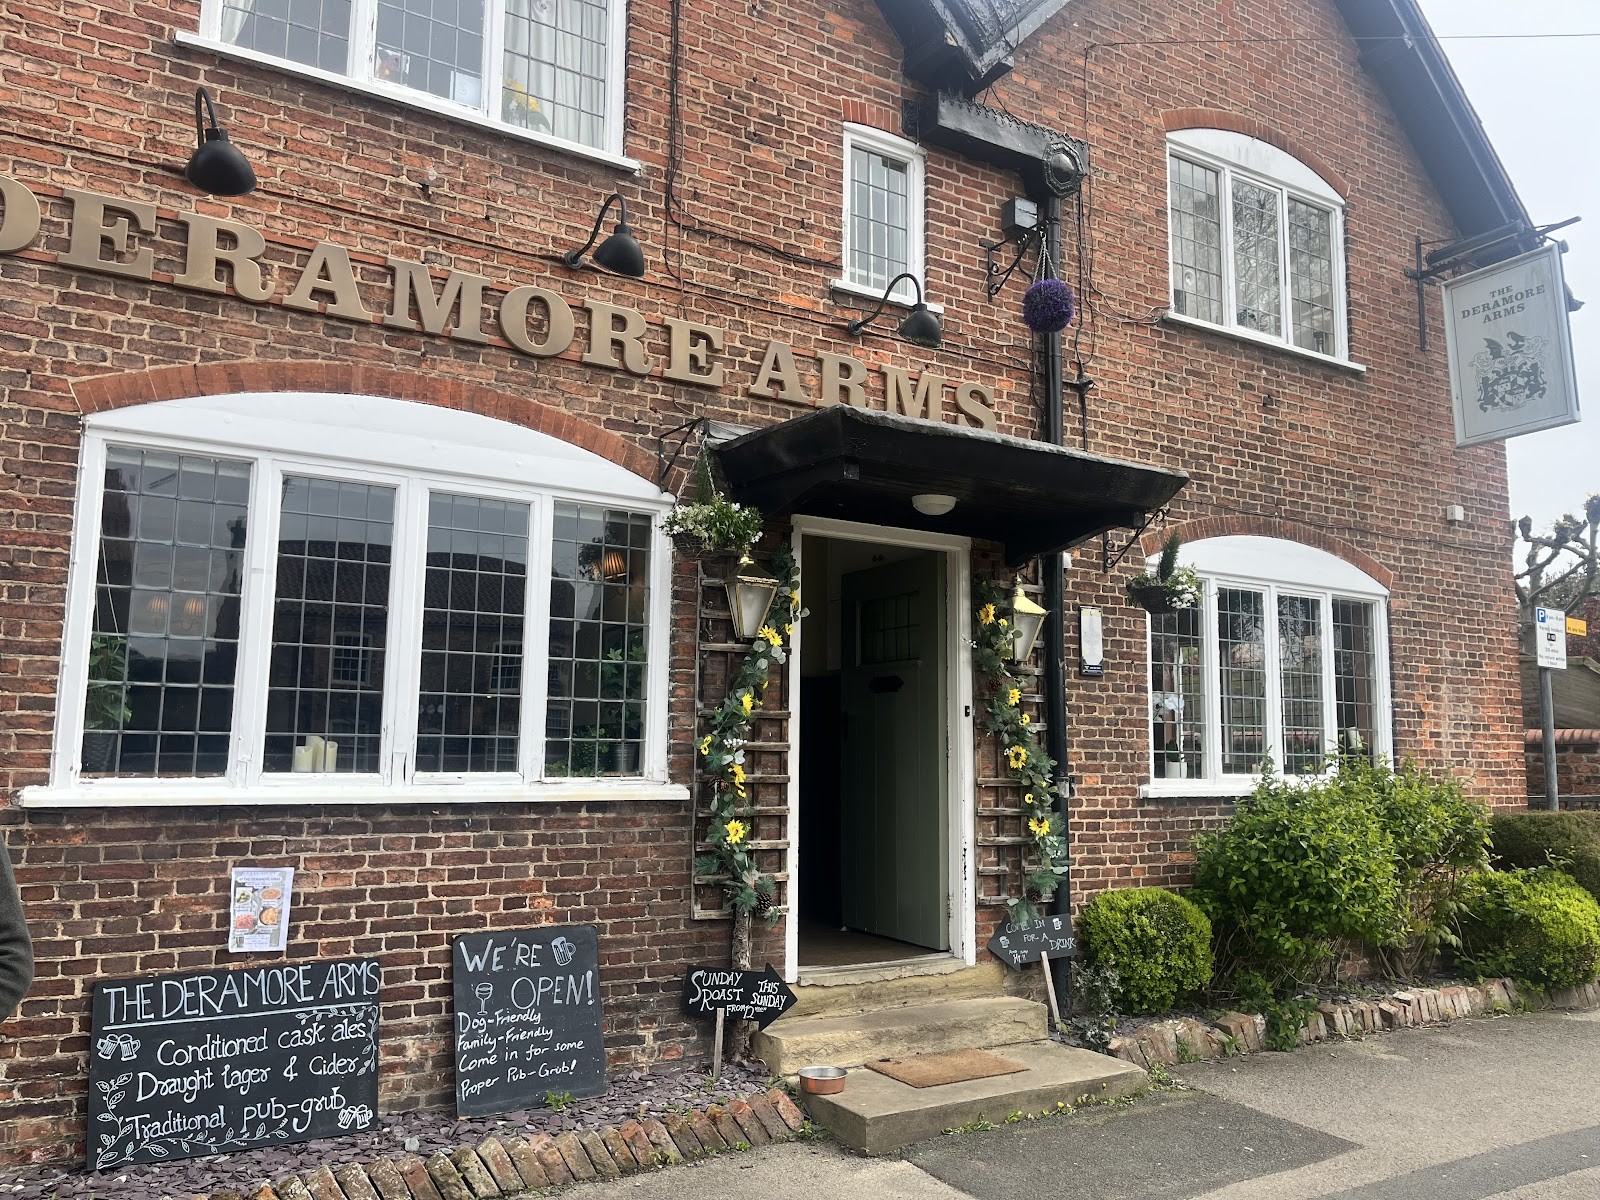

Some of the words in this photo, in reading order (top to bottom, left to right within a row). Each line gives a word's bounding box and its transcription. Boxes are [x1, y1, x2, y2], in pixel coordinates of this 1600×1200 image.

[1461, 284, 1546, 319] DERAMORE
[1489, 285, 1514, 299] THE
[1483, 302, 1526, 324] ARMS
[749, 340, 998, 431] ARMS
[1023, 933, 1040, 943] FOR
[1040, 932, 1049, 942] A
[1034, 919, 1046, 929] IN
[460, 937, 543, 972] WE'RE
[1048, 938, 1077, 951] DRINK
[102, 982, 155, 1023] THE
[161, 965, 315, 1018] DERAMORE
[319, 961, 380, 999] ARMS
[511, 969, 595, 1010] OPEN!
[688, 969, 743, 1005] SUNDAY
[699, 987, 744, 1012] ROAST
[750, 992, 788, 1011] SUNDAY
[757, 979, 780, 995] THIS
[457, 1008, 541, 1033] Dog-Friendly
[726, 1004, 748, 1017] FROM
[157, 1028, 269, 1066] Conditioned
[277, 1021, 327, 1049] cask
[330, 1018, 367, 1043] ales
[457, 1026, 554, 1054] Family-Friendly
[458, 1054, 498, 1073] Come
[504, 1047, 519, 1061] in
[525, 1043, 550, 1061] for
[553, 1040, 586, 1052] some
[135, 1067, 215, 1103] Draught
[221, 1064, 272, 1095] lager
[282, 1055, 299, 1081] &
[308, 1052, 359, 1077] Cider
[460, 1076, 500, 1101] Proper
[506, 1059, 578, 1083] Pub-Grub!
[126, 1105, 227, 1142] Traditional
[239, 1086, 347, 1133] pub-grub
